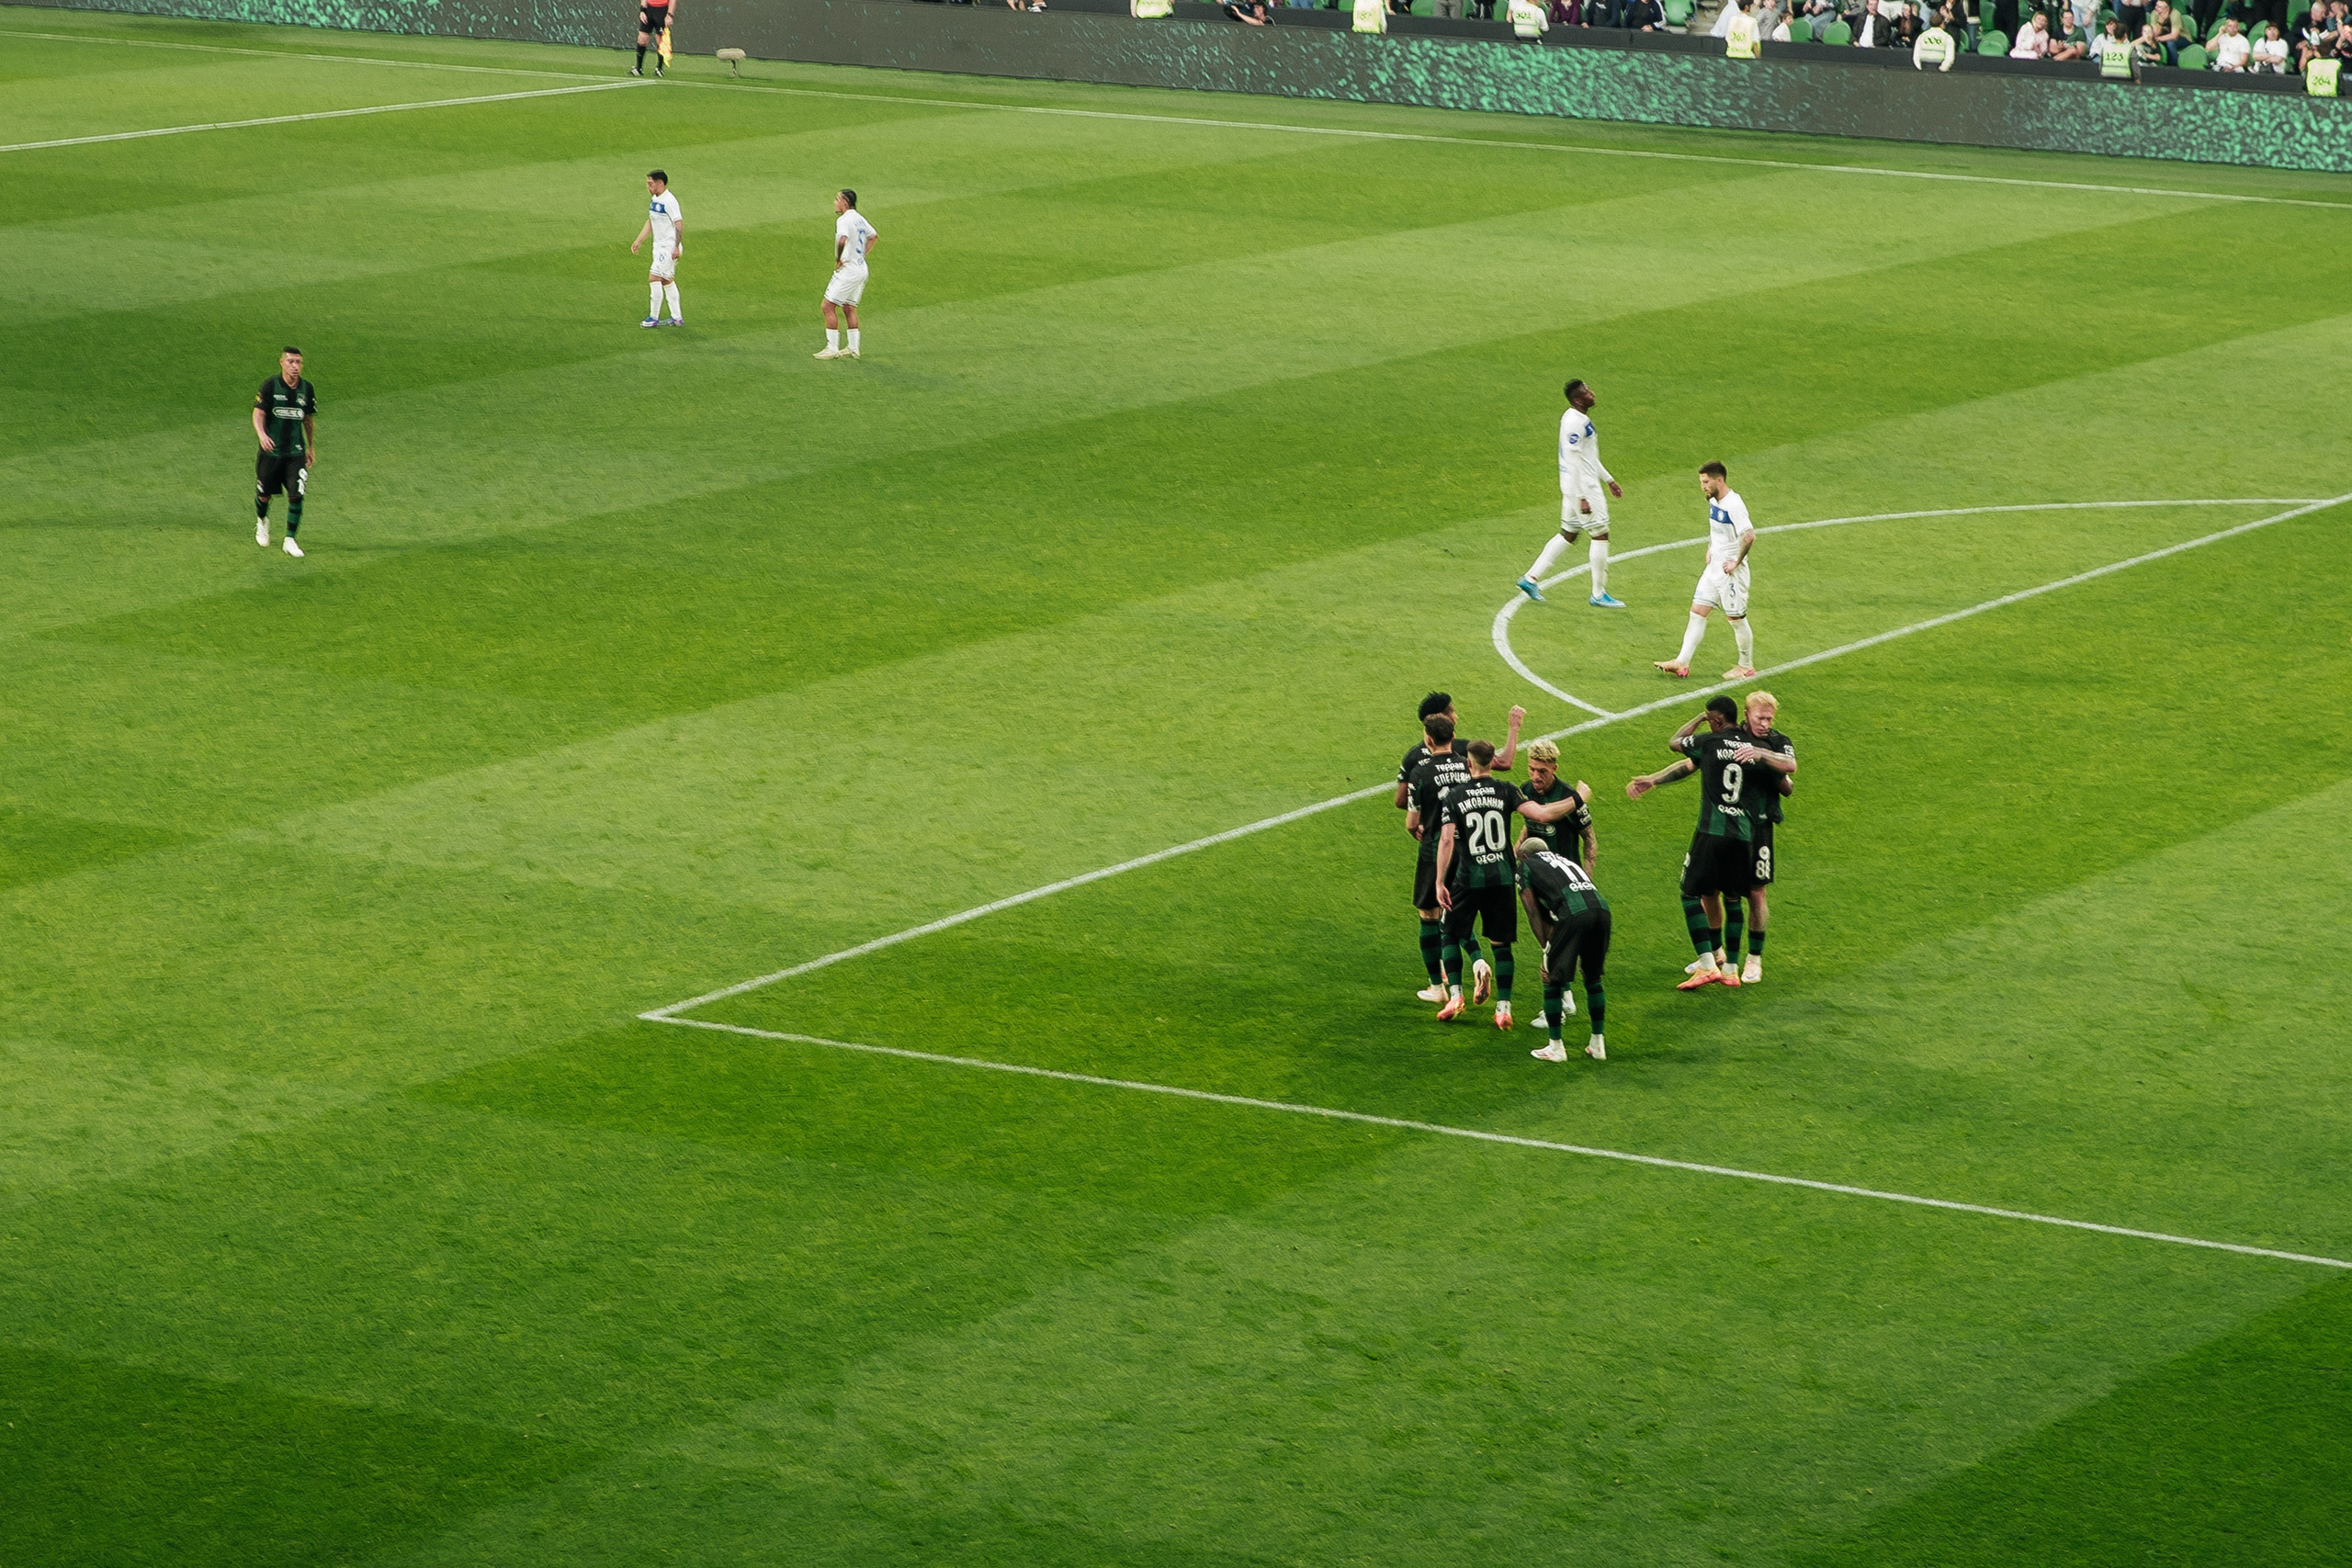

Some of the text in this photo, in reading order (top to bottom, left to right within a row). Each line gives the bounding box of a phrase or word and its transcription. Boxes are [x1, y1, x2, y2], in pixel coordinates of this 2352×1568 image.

[2106, 52, 2124, 62] 123
[1729, 582, 1736, 598] 3
[1721, 762, 1744, 805] 9
[1465, 810, 1507, 856] 20
[1550, 859, 1592, 883] 11
